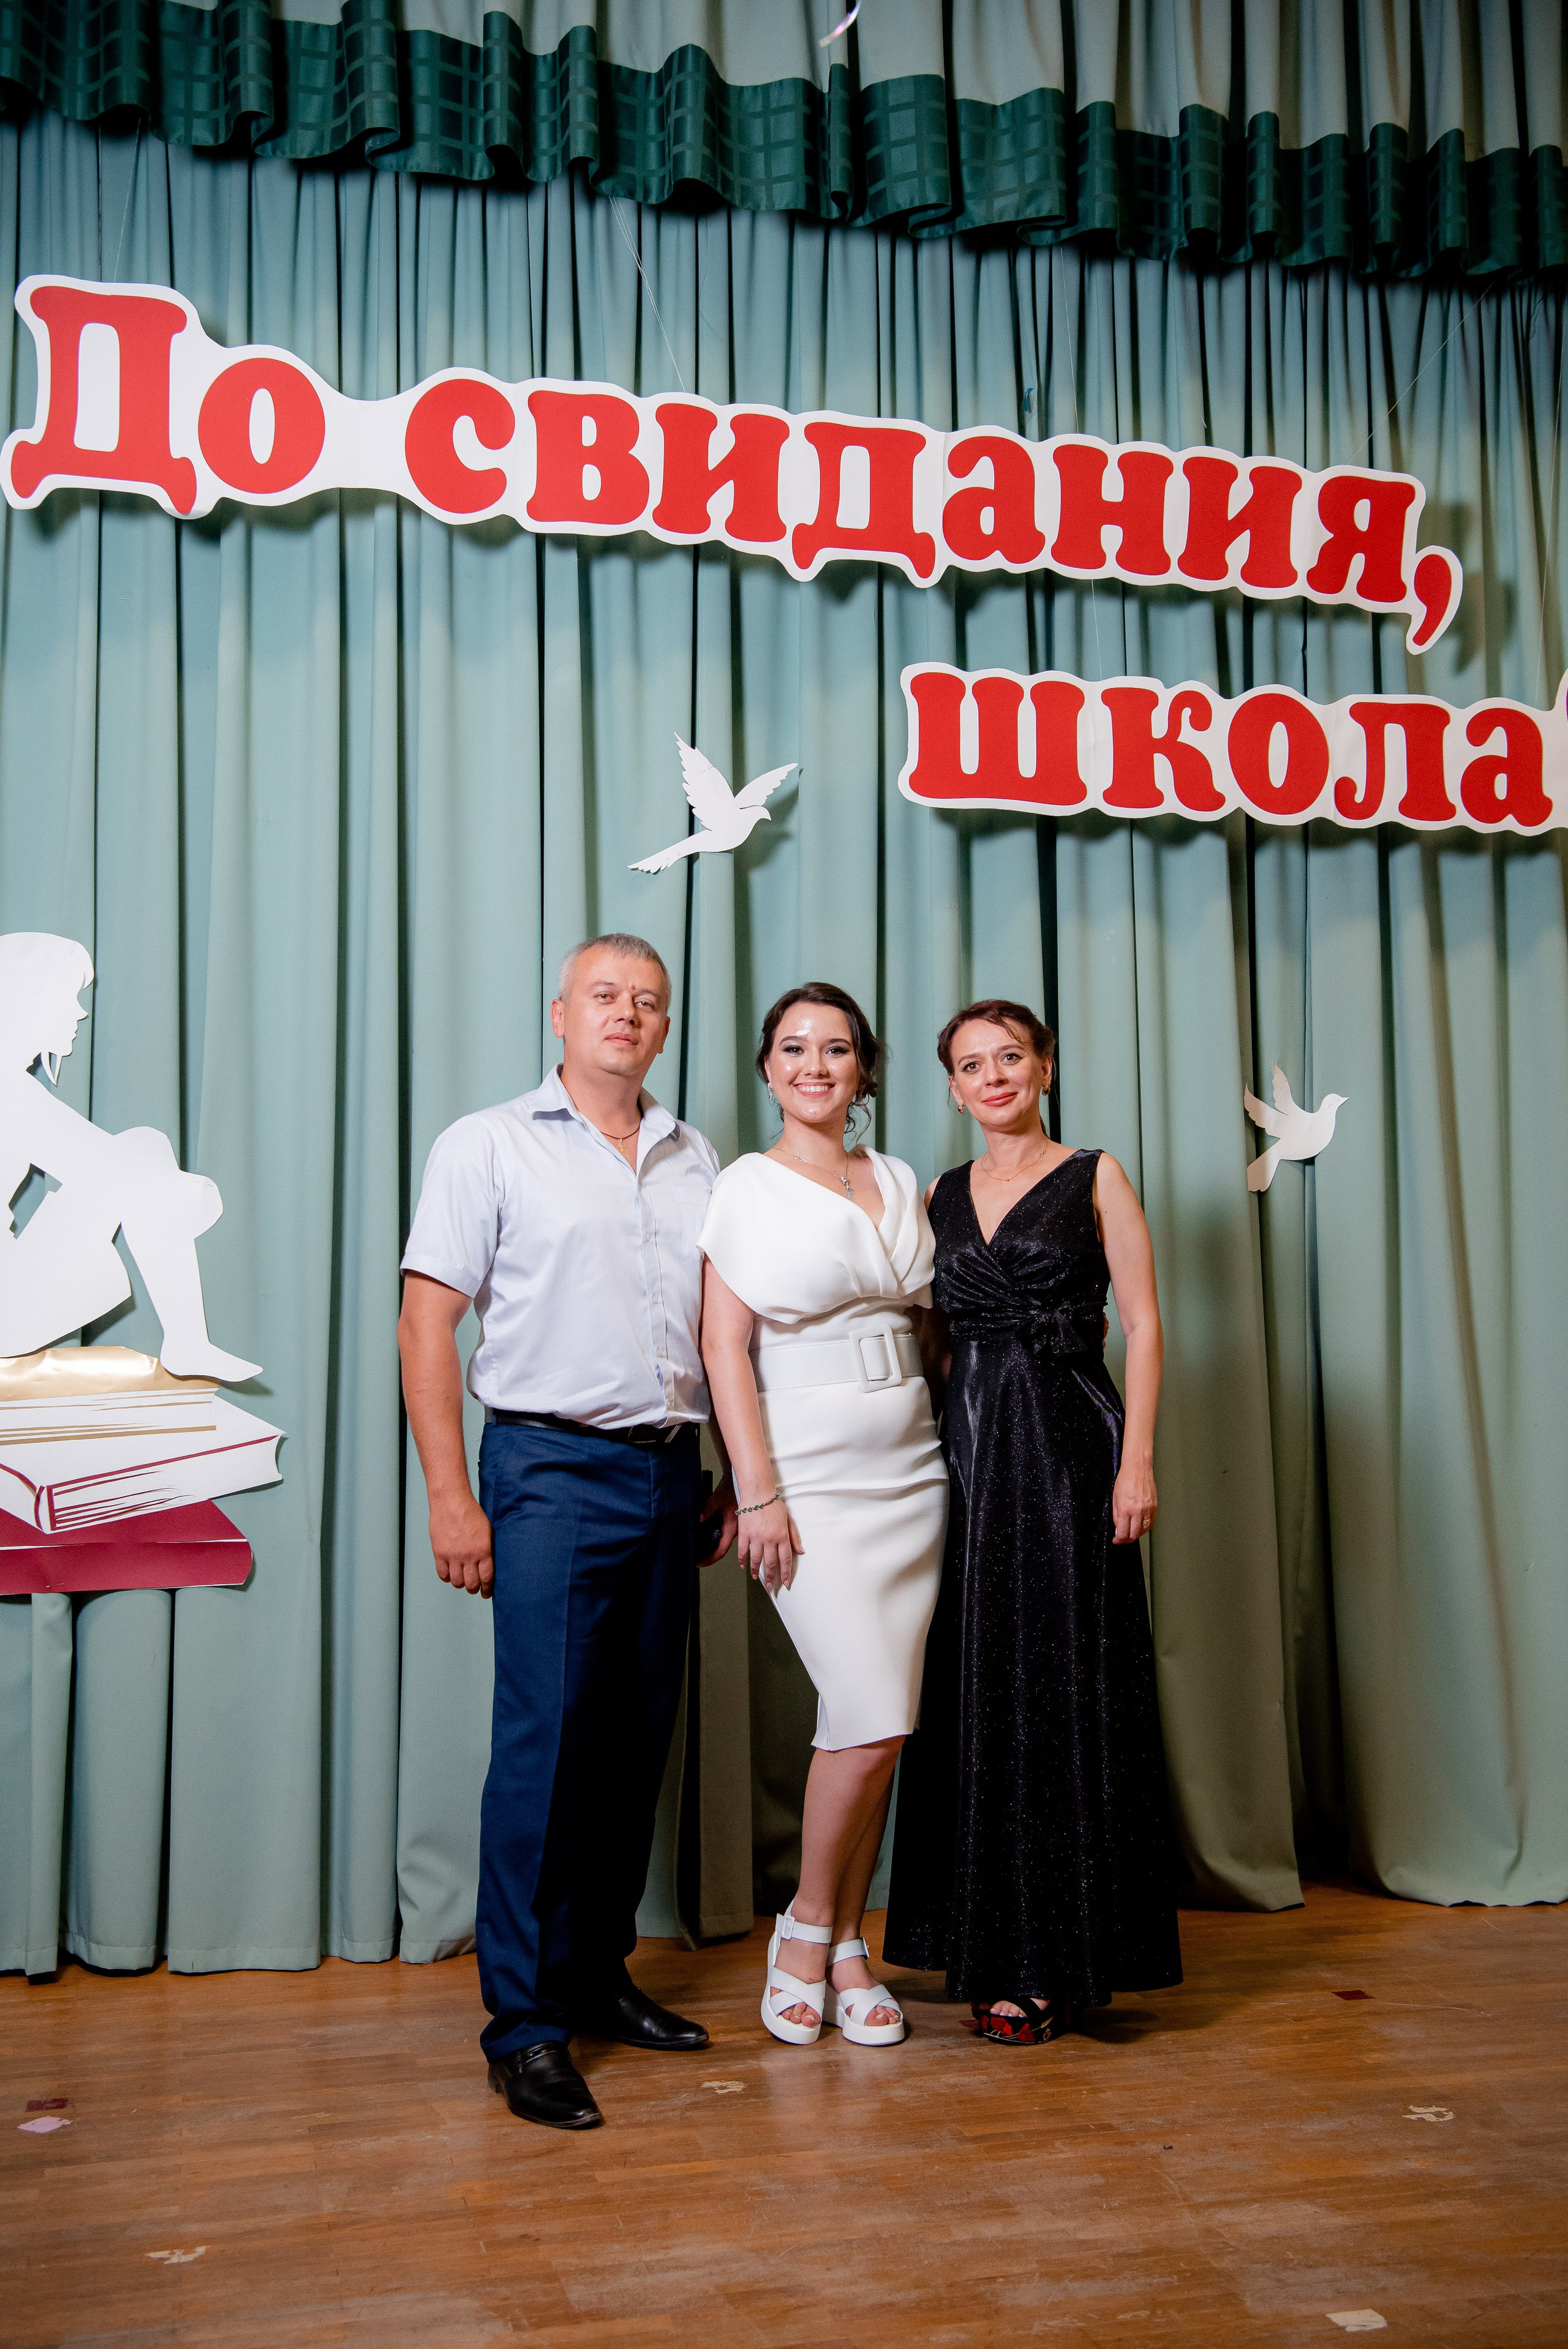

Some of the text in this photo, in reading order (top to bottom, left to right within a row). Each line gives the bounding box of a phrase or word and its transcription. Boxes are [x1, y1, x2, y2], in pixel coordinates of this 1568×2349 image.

[11, 285, 1454, 647] До свидания,
[909, 671, 1568, 827] школа
